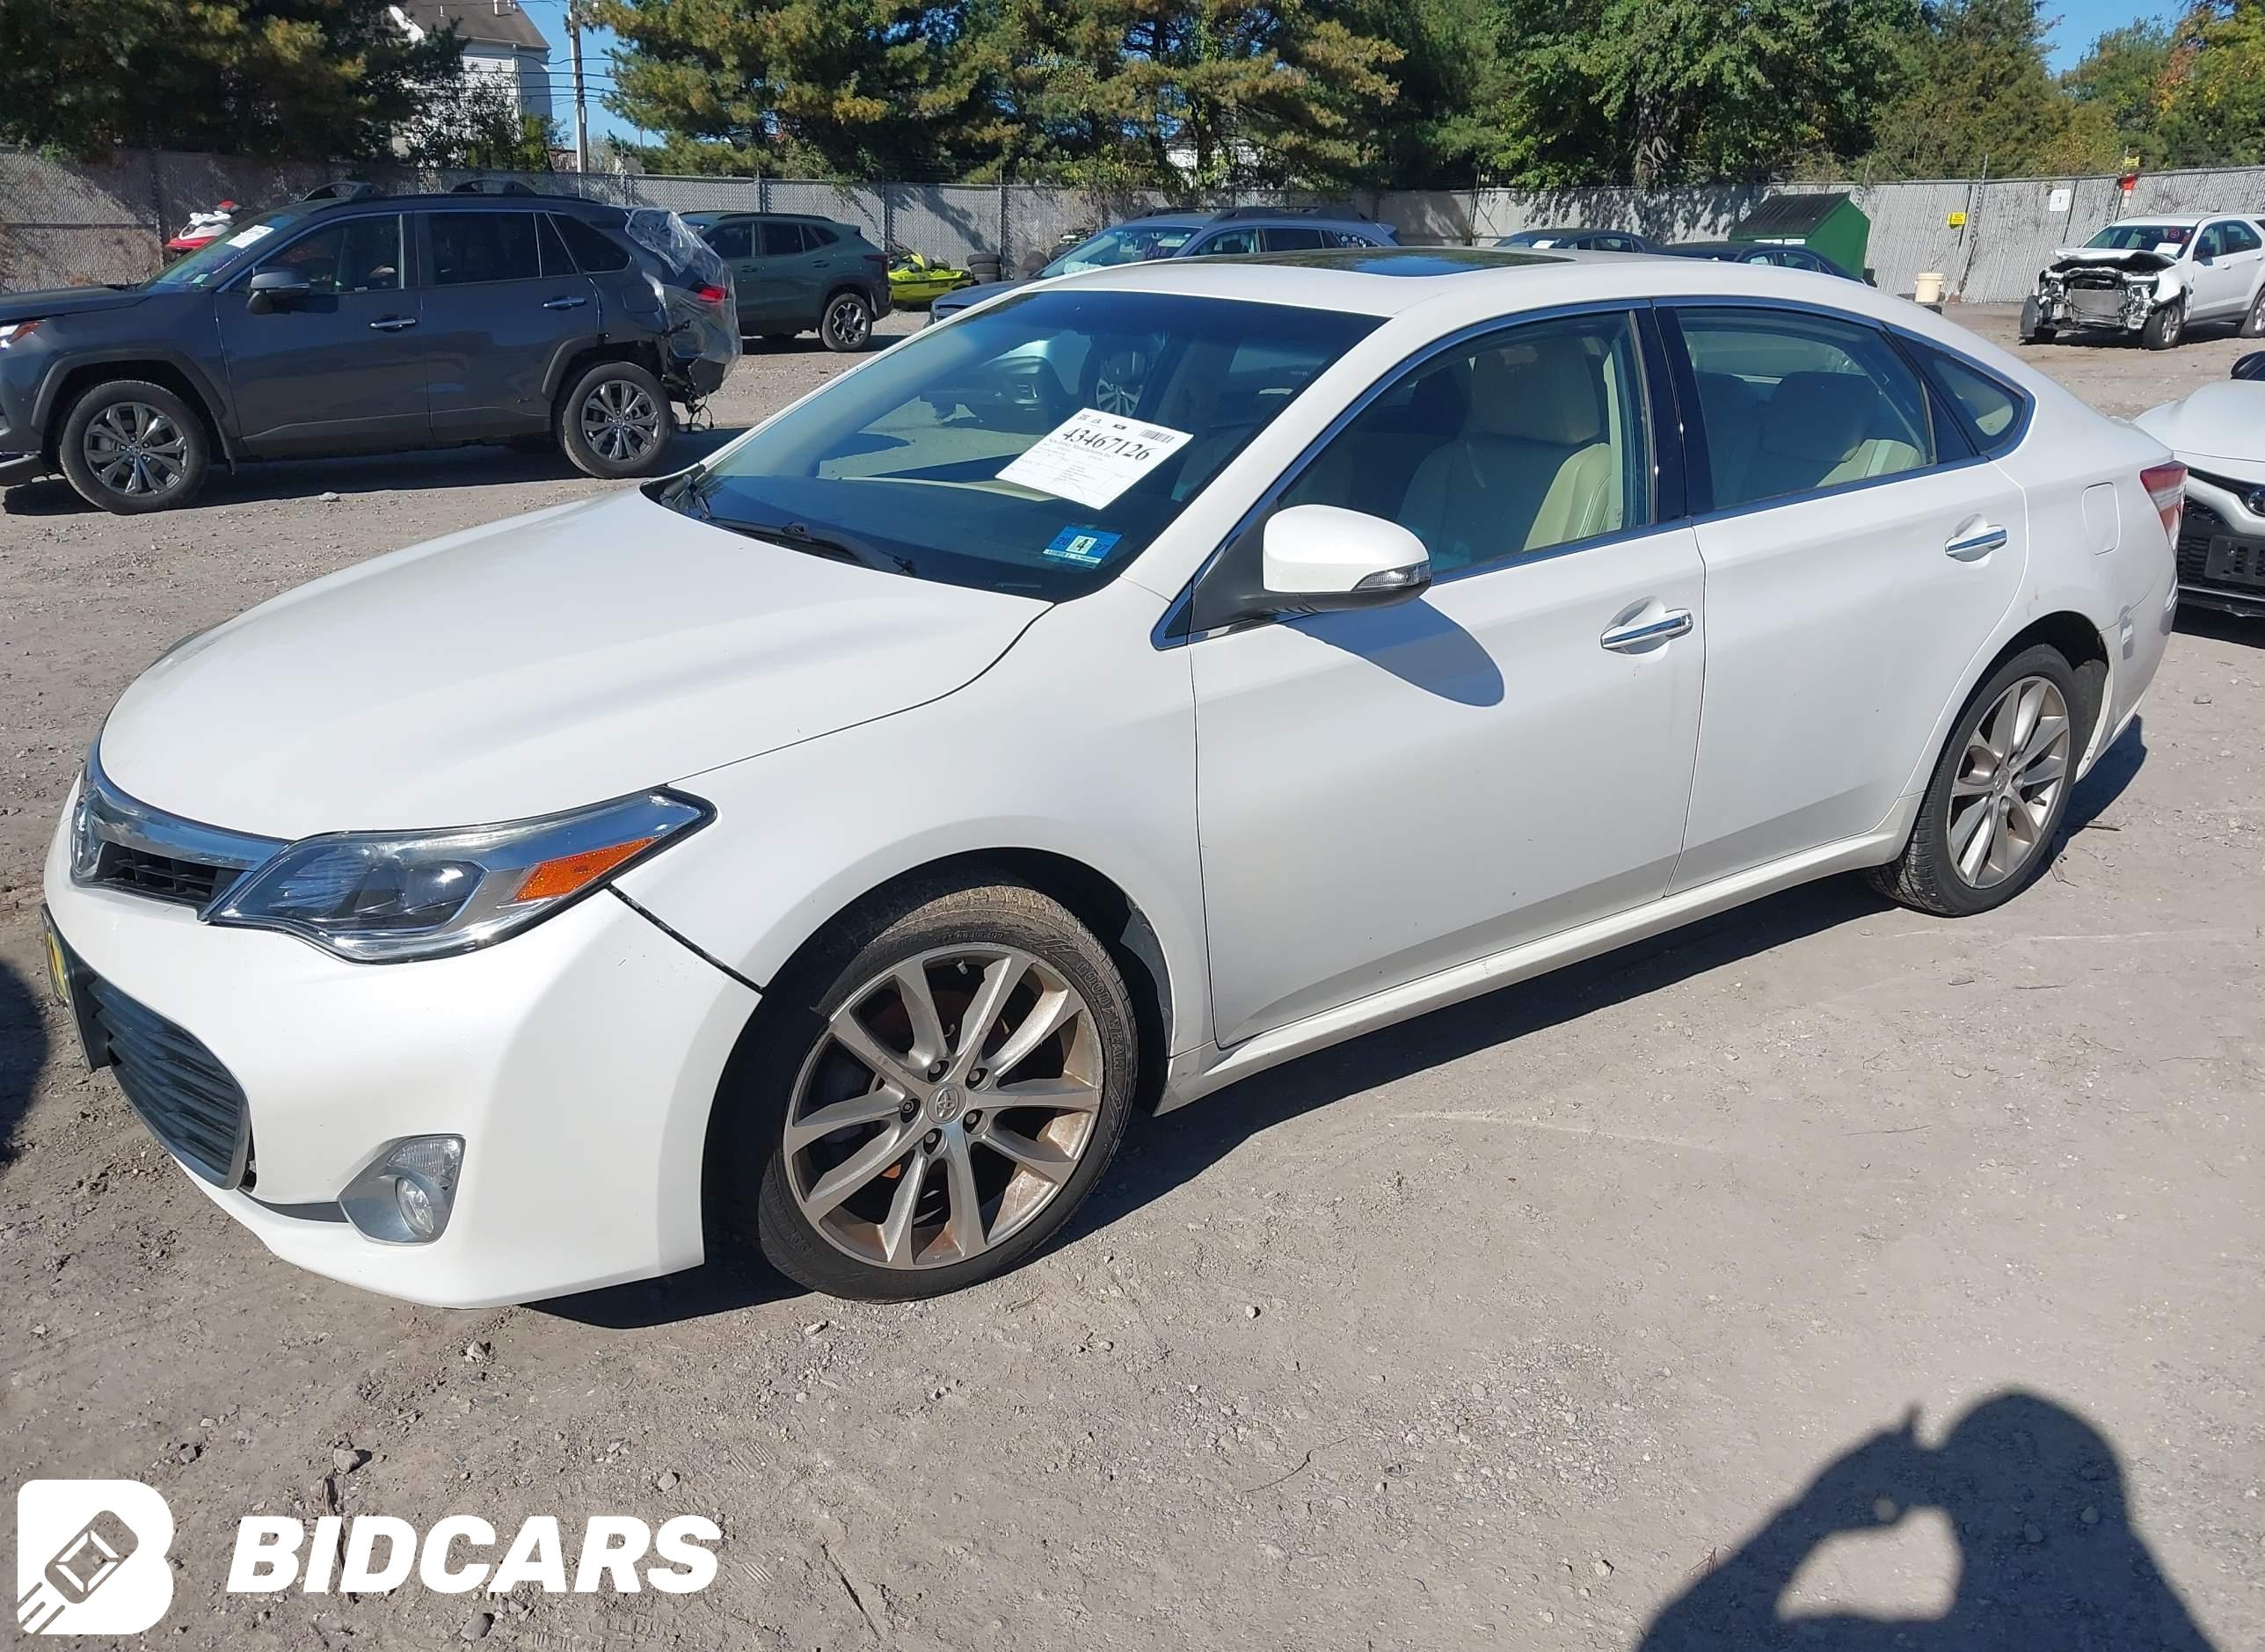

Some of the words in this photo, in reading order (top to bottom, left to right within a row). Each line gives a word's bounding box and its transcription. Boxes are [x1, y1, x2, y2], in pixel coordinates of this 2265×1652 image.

[1062, 427, 1161, 462] 43467126
[1055, 537, 1071, 546] 20
[1076, 538, 1089, 552] 4
[1094, 543, 1110, 552] 27
